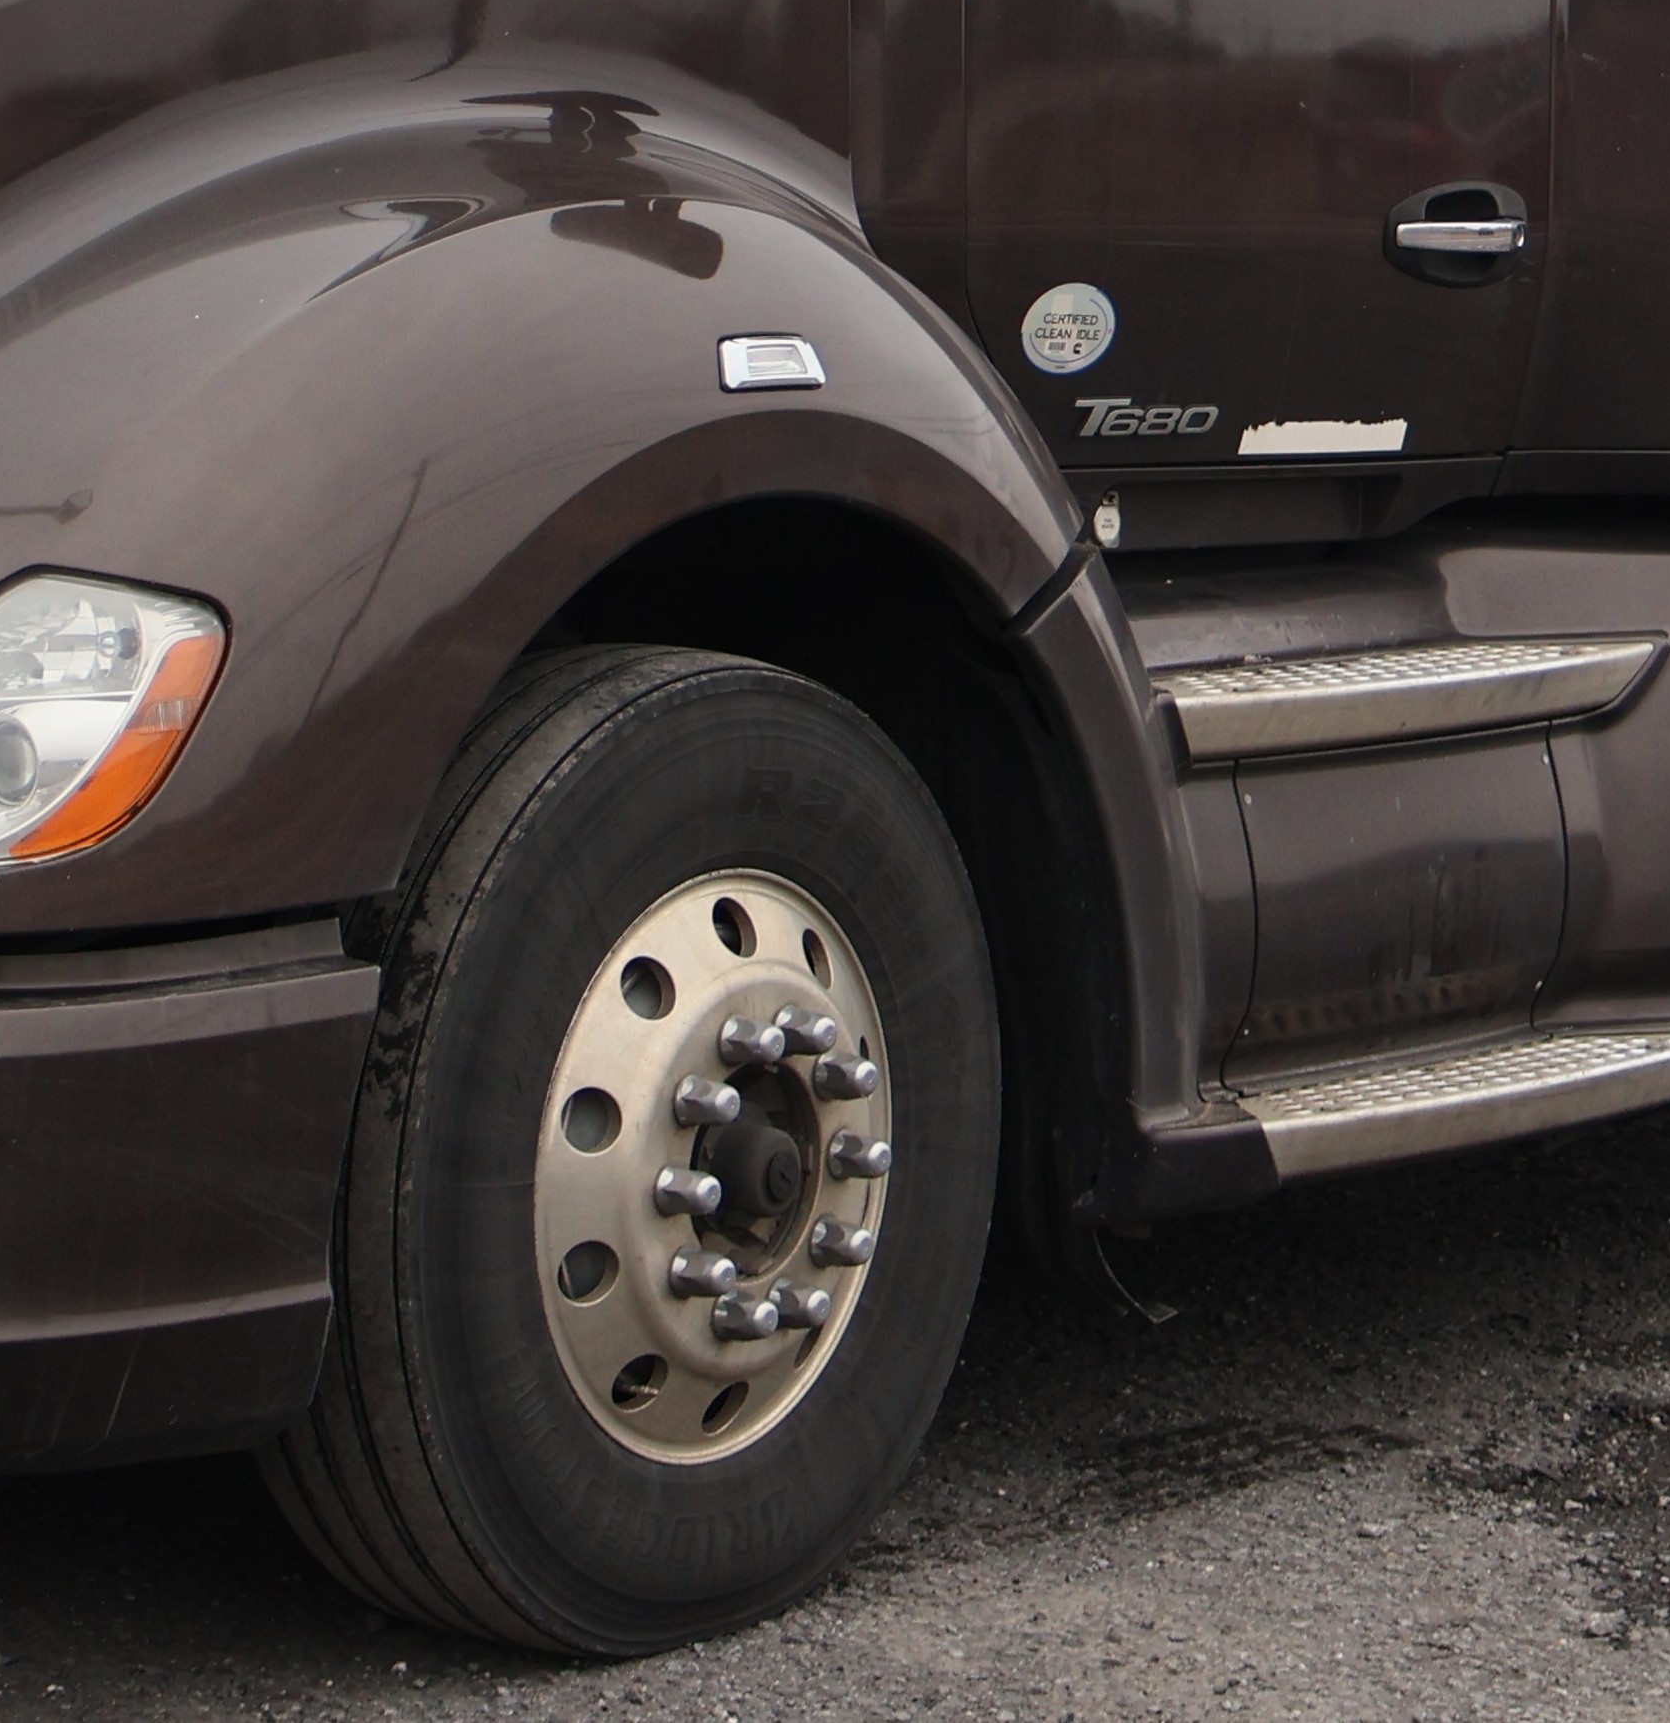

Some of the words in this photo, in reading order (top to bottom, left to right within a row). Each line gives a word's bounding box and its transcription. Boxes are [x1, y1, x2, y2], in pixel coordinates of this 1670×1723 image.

[1043, 313, 1099, 326] CERTIFIED
[1034, 327, 1072, 339] CLEAN
[1076, 329, 1100, 341] IDLE
[1074, 398, 1220, 437] T680
